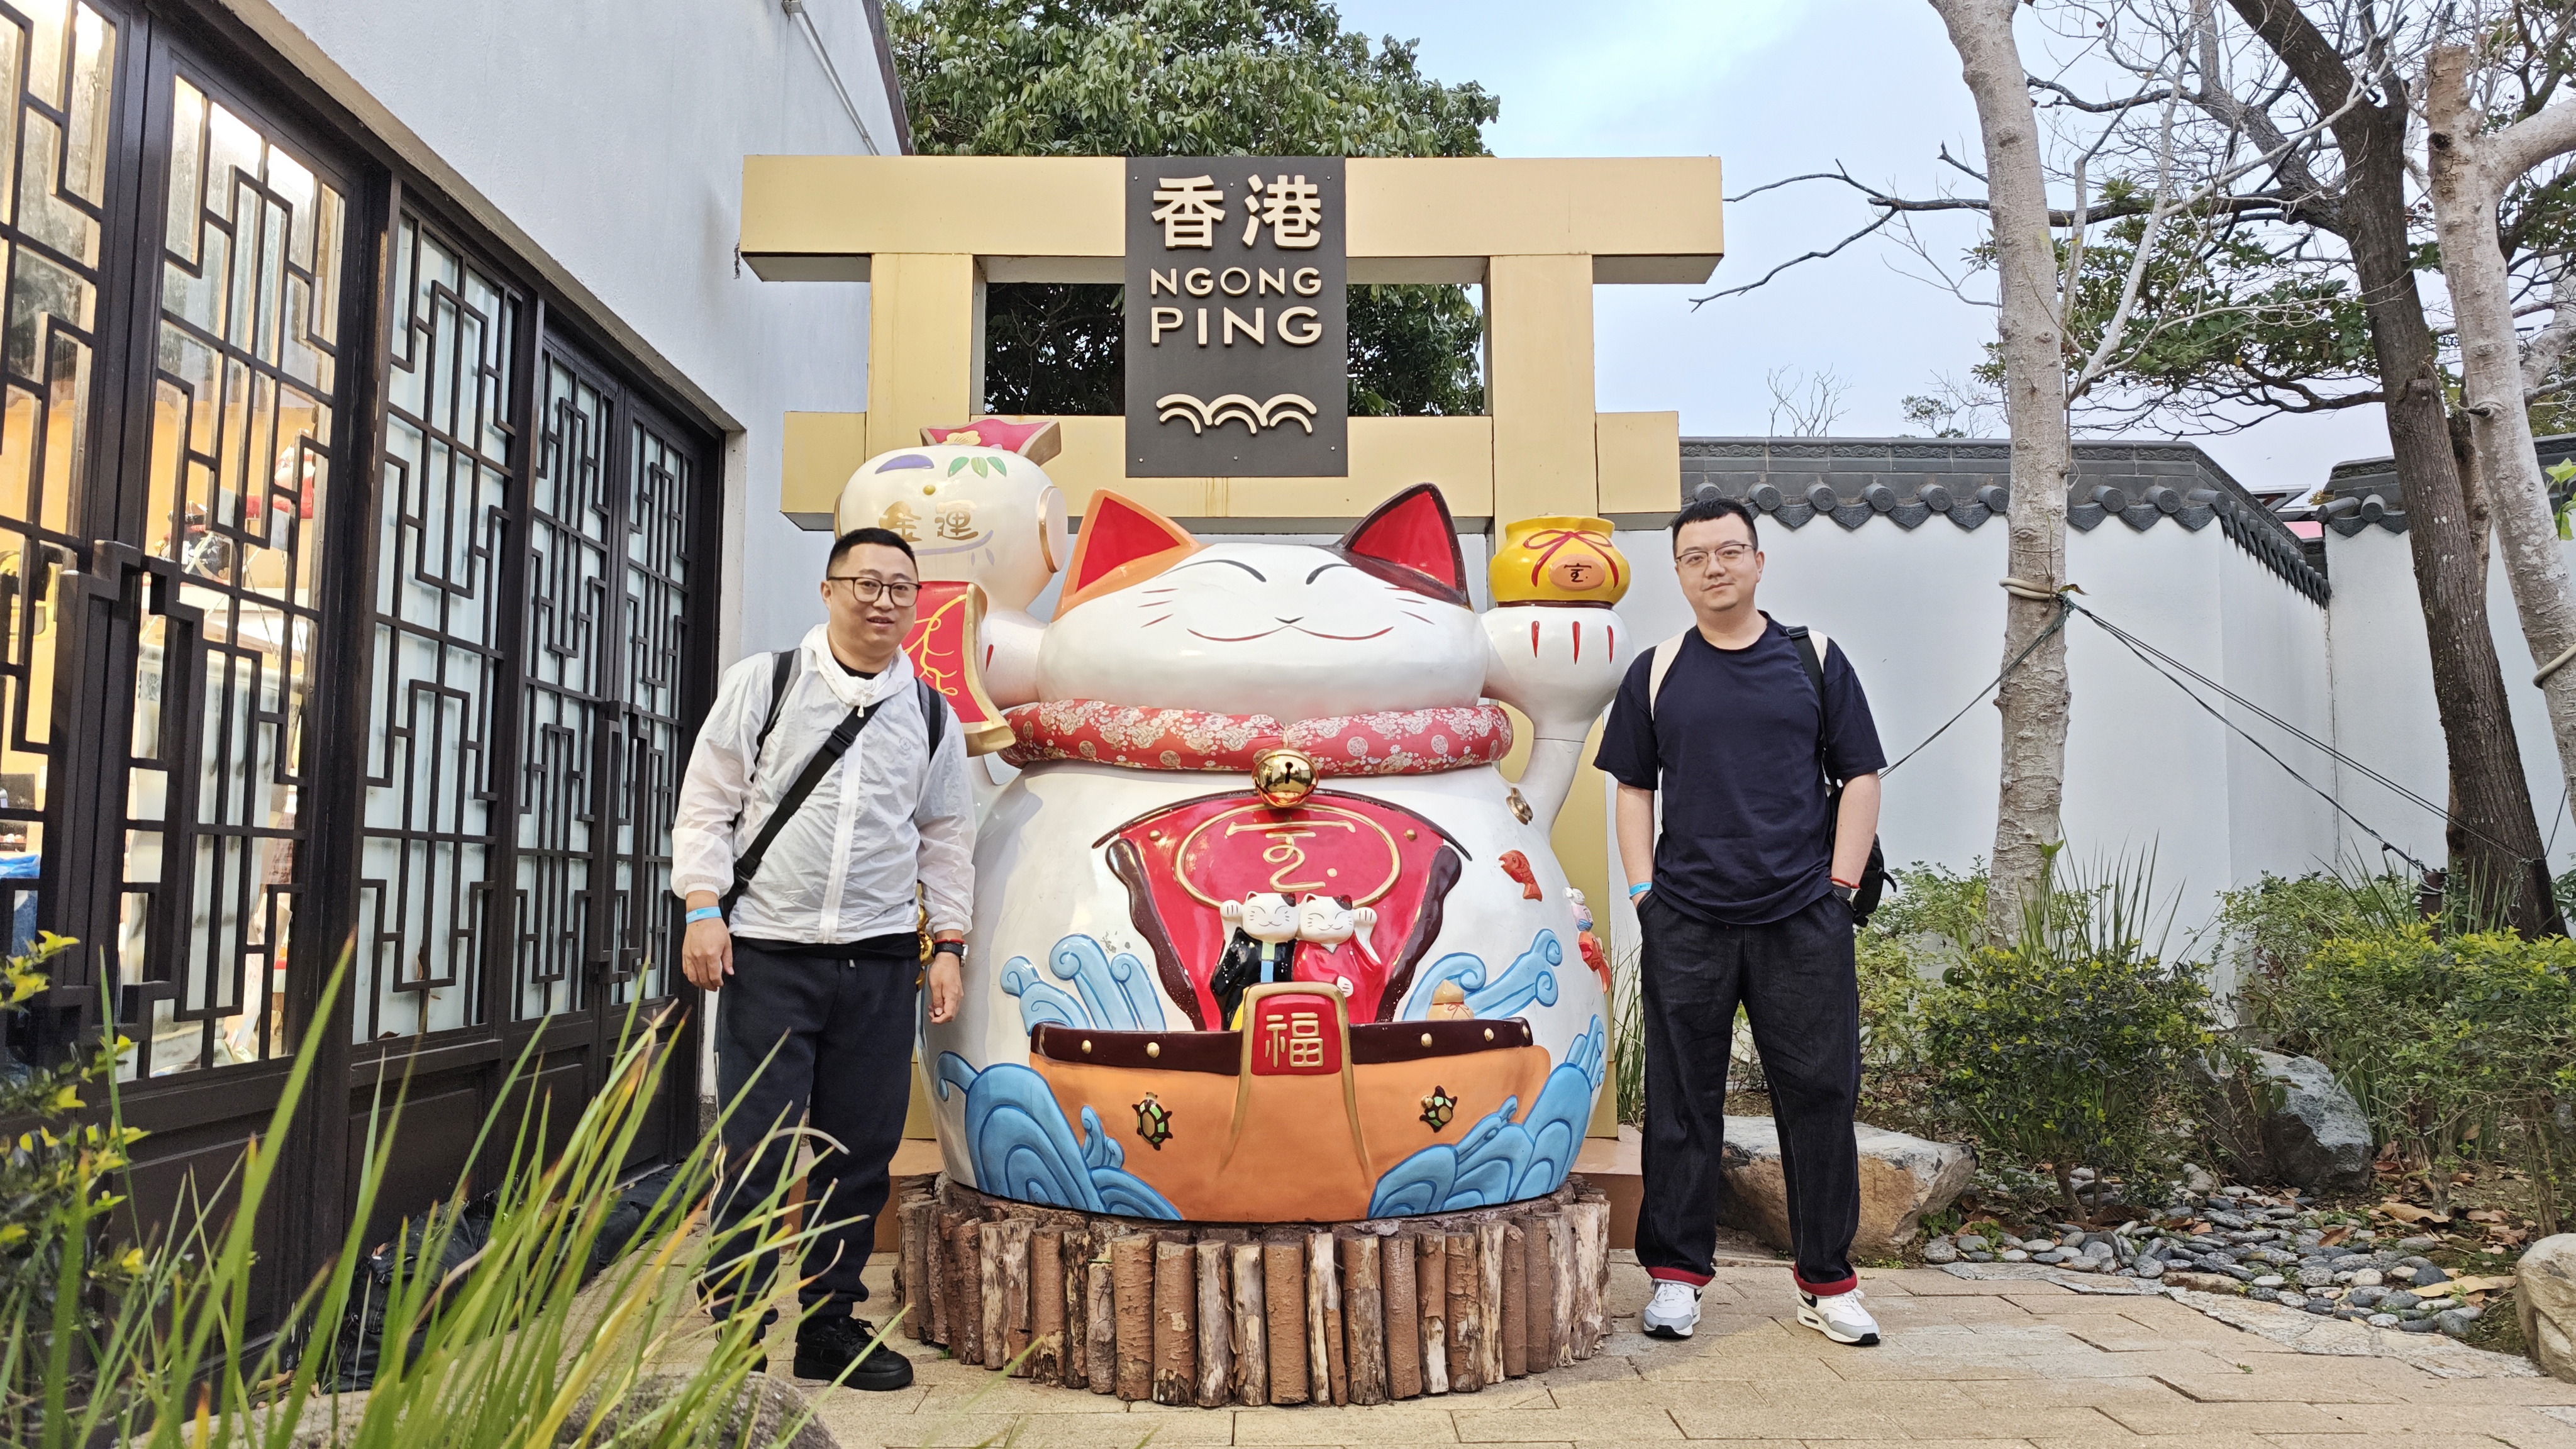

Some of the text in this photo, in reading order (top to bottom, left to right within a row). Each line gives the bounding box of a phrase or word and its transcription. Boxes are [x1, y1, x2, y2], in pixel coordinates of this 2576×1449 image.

[1151, 174, 1322, 249] 香港
[1150, 267, 1322, 297] NGONG
[1150, 306, 1323, 346] PING
[1265, 1012, 1324, 1068] 福
